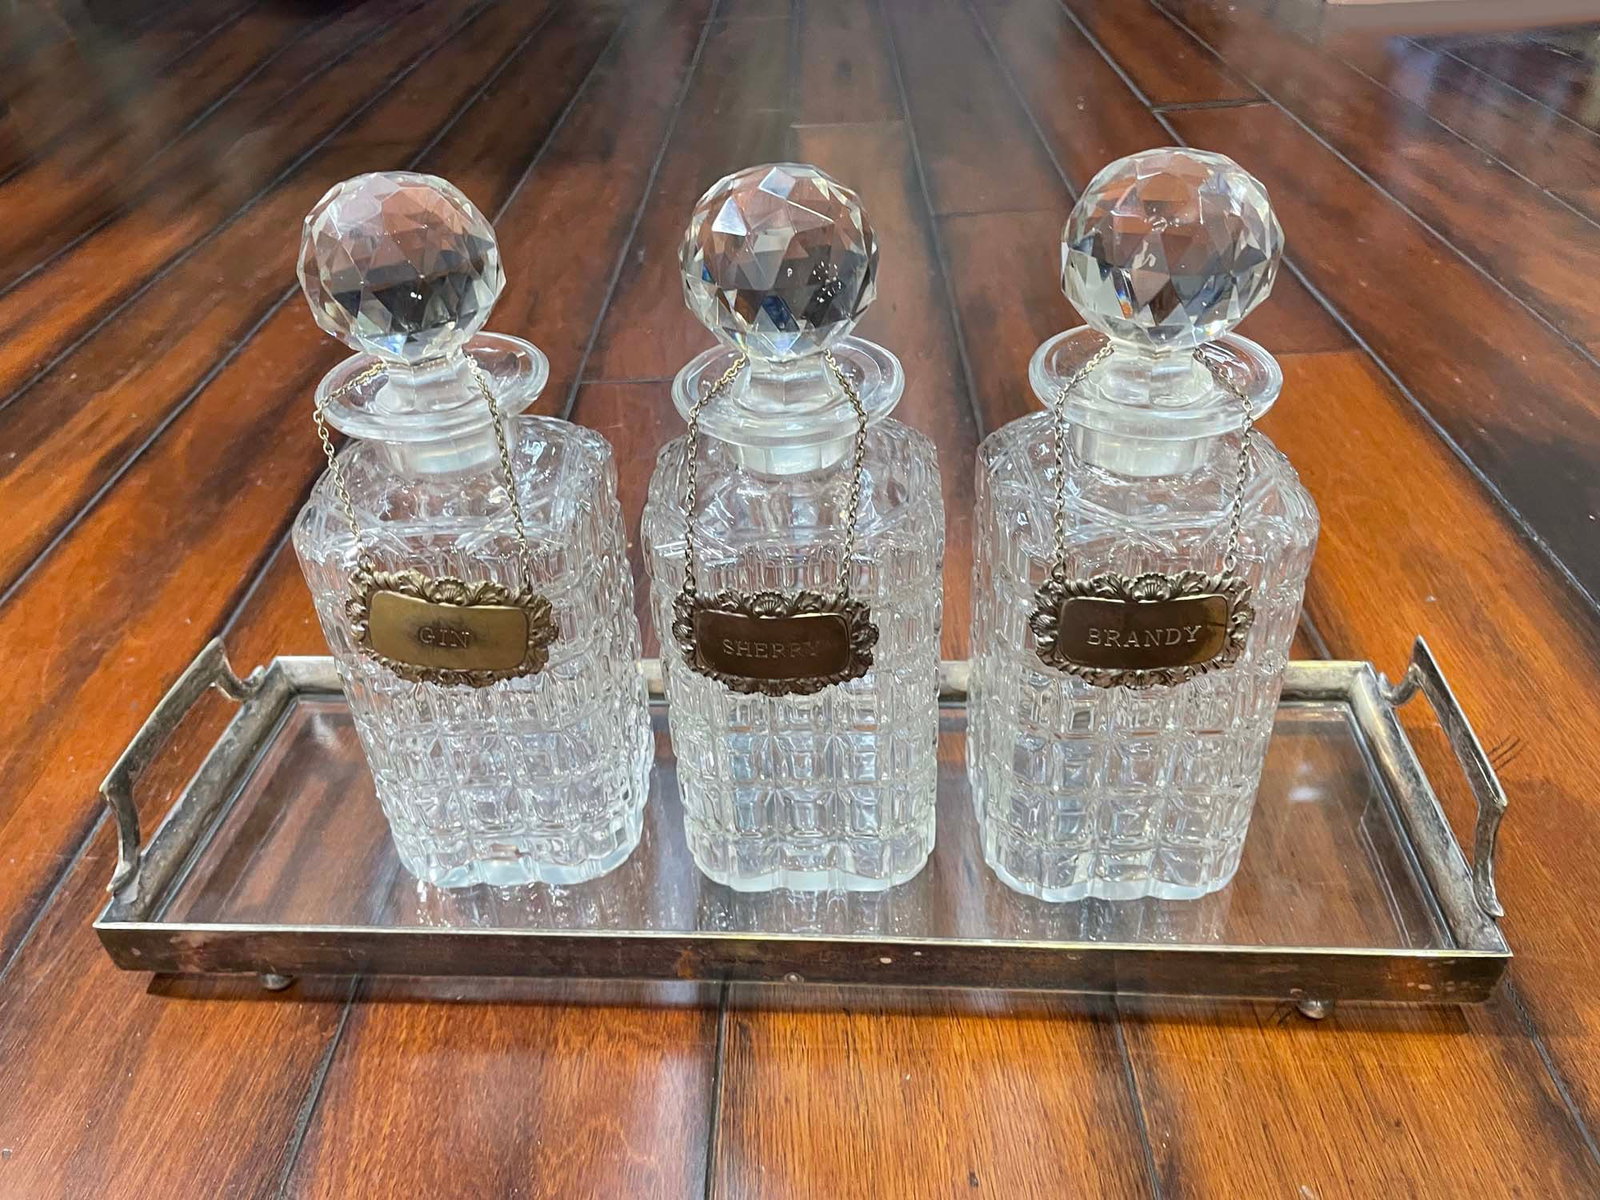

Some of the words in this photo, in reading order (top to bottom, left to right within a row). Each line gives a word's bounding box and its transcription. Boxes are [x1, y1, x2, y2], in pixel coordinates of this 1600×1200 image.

[419, 626, 470, 649] GIN
[1086, 625, 1202, 648] BRANDY
[722, 638, 820, 659] SHERRY
